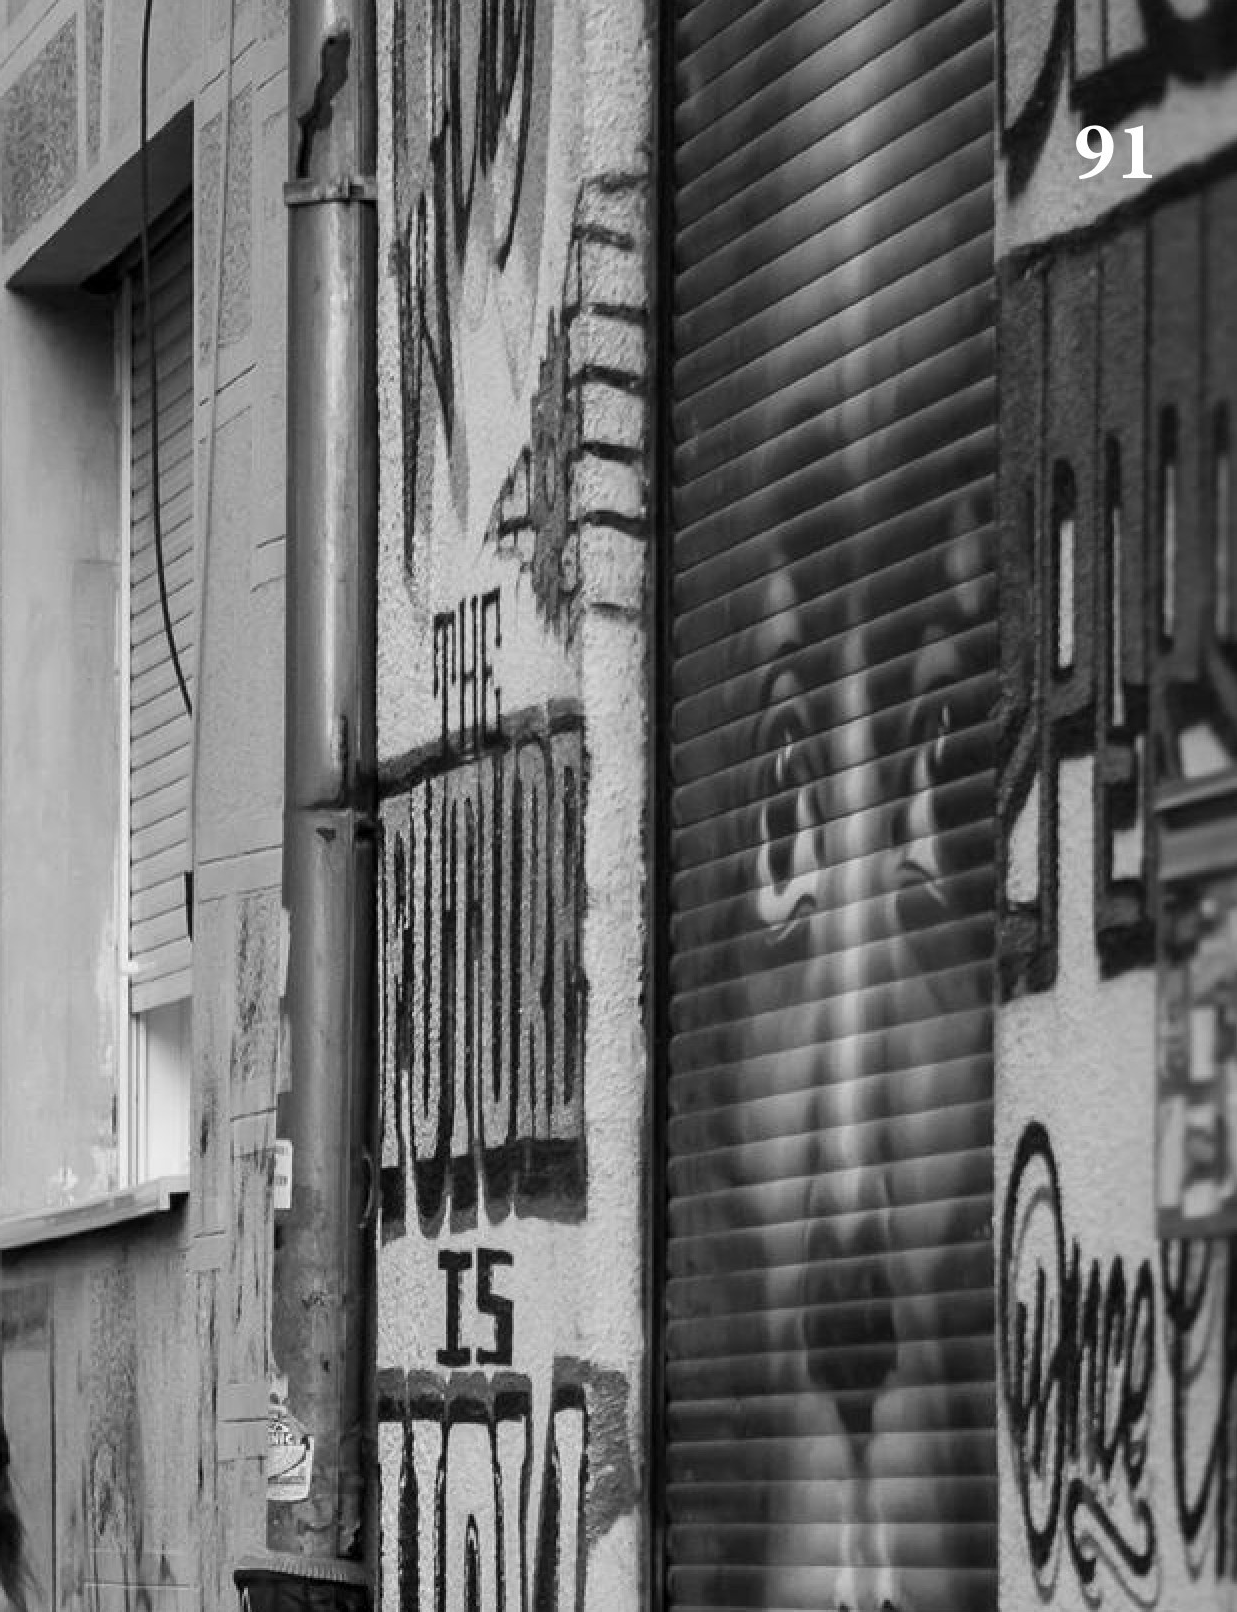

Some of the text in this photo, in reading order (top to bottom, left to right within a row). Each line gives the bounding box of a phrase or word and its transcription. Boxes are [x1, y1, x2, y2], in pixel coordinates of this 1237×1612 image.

[433, 587, 503, 758] THE
[376, 715, 588, 1205] FUTURE
[436, 1247, 514, 1367] IS
